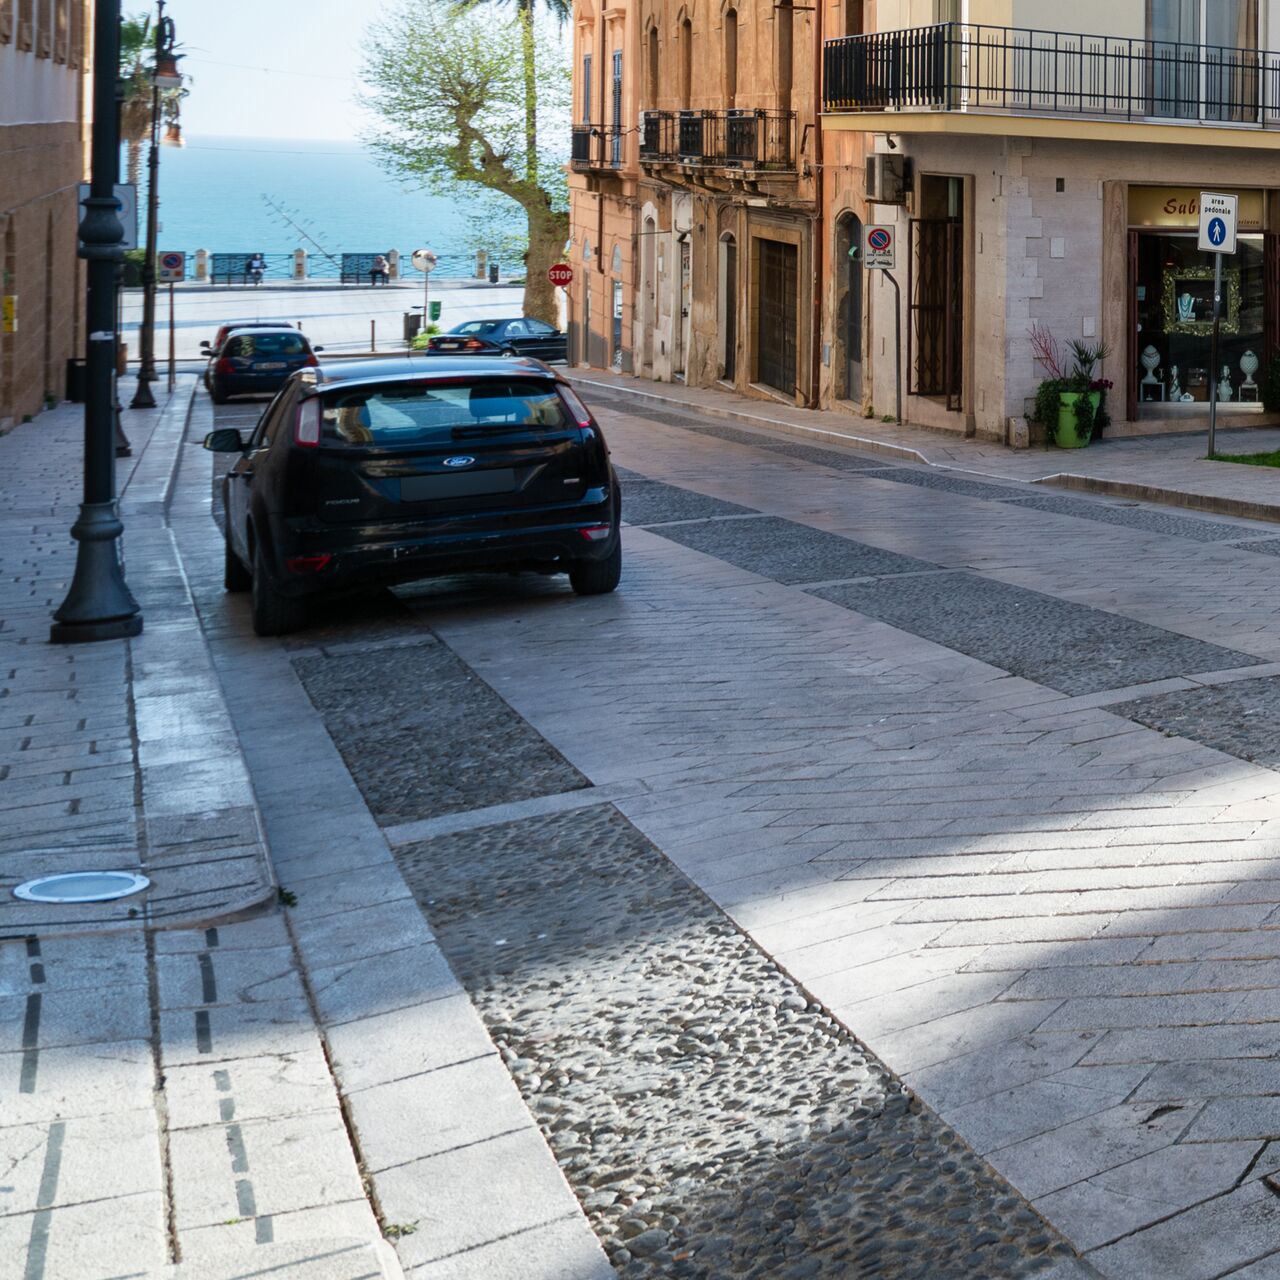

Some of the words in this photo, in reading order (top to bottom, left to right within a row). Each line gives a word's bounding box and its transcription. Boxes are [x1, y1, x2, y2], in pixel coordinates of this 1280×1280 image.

[1163, 198, 1199, 215] Sab
[1211, 198, 1224, 206] area
[1204, 206, 1231, 215] pedonale
[549, 270, 572, 280] STOP
